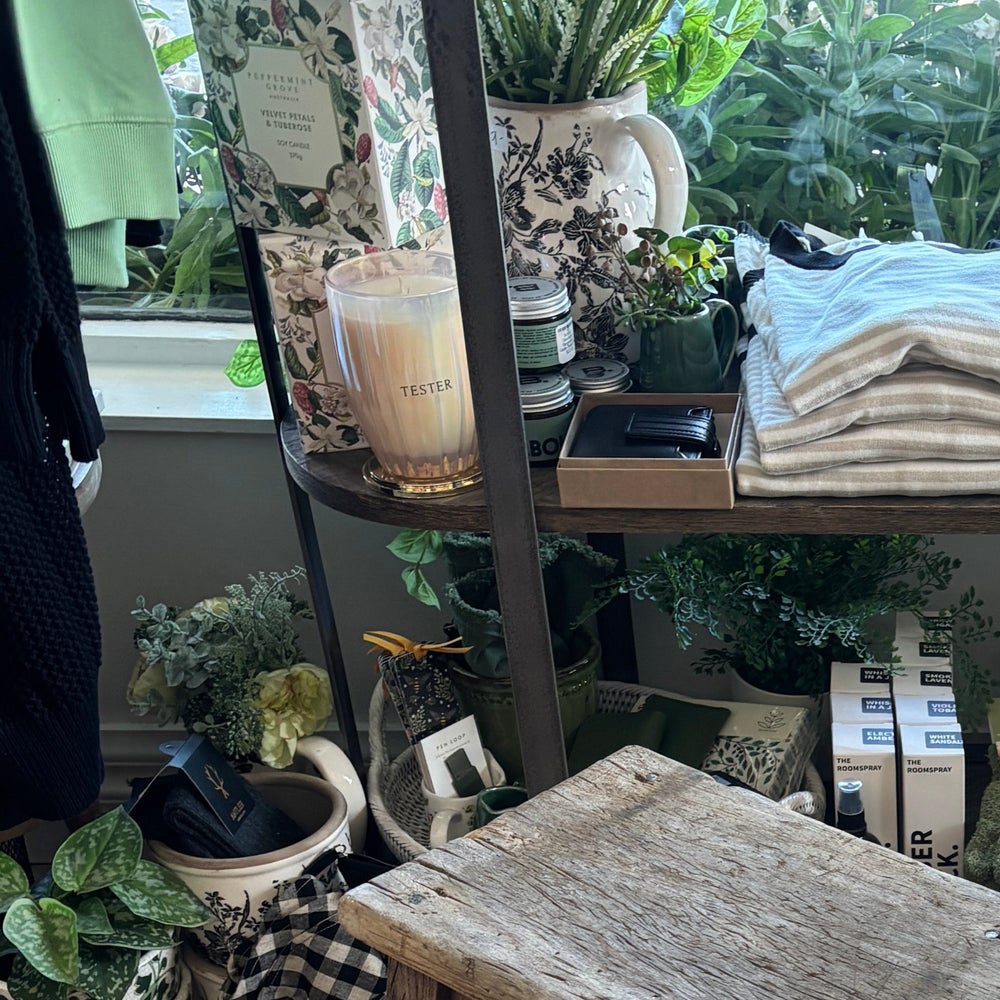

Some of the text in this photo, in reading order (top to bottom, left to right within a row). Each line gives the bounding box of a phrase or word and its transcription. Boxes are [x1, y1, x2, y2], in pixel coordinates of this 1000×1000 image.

[247, 71, 314, 87] PEPPERMINT
[265, 82, 299, 94] GROVE
[261, 108, 316, 123] VELVET PETALS
[266, 119, 312, 132] & TUBEROSE
[276, 138, 311, 150] SOY CANDLE
[400, 379, 453, 397] TESTER
[450, 733, 466, 744] LOOP
